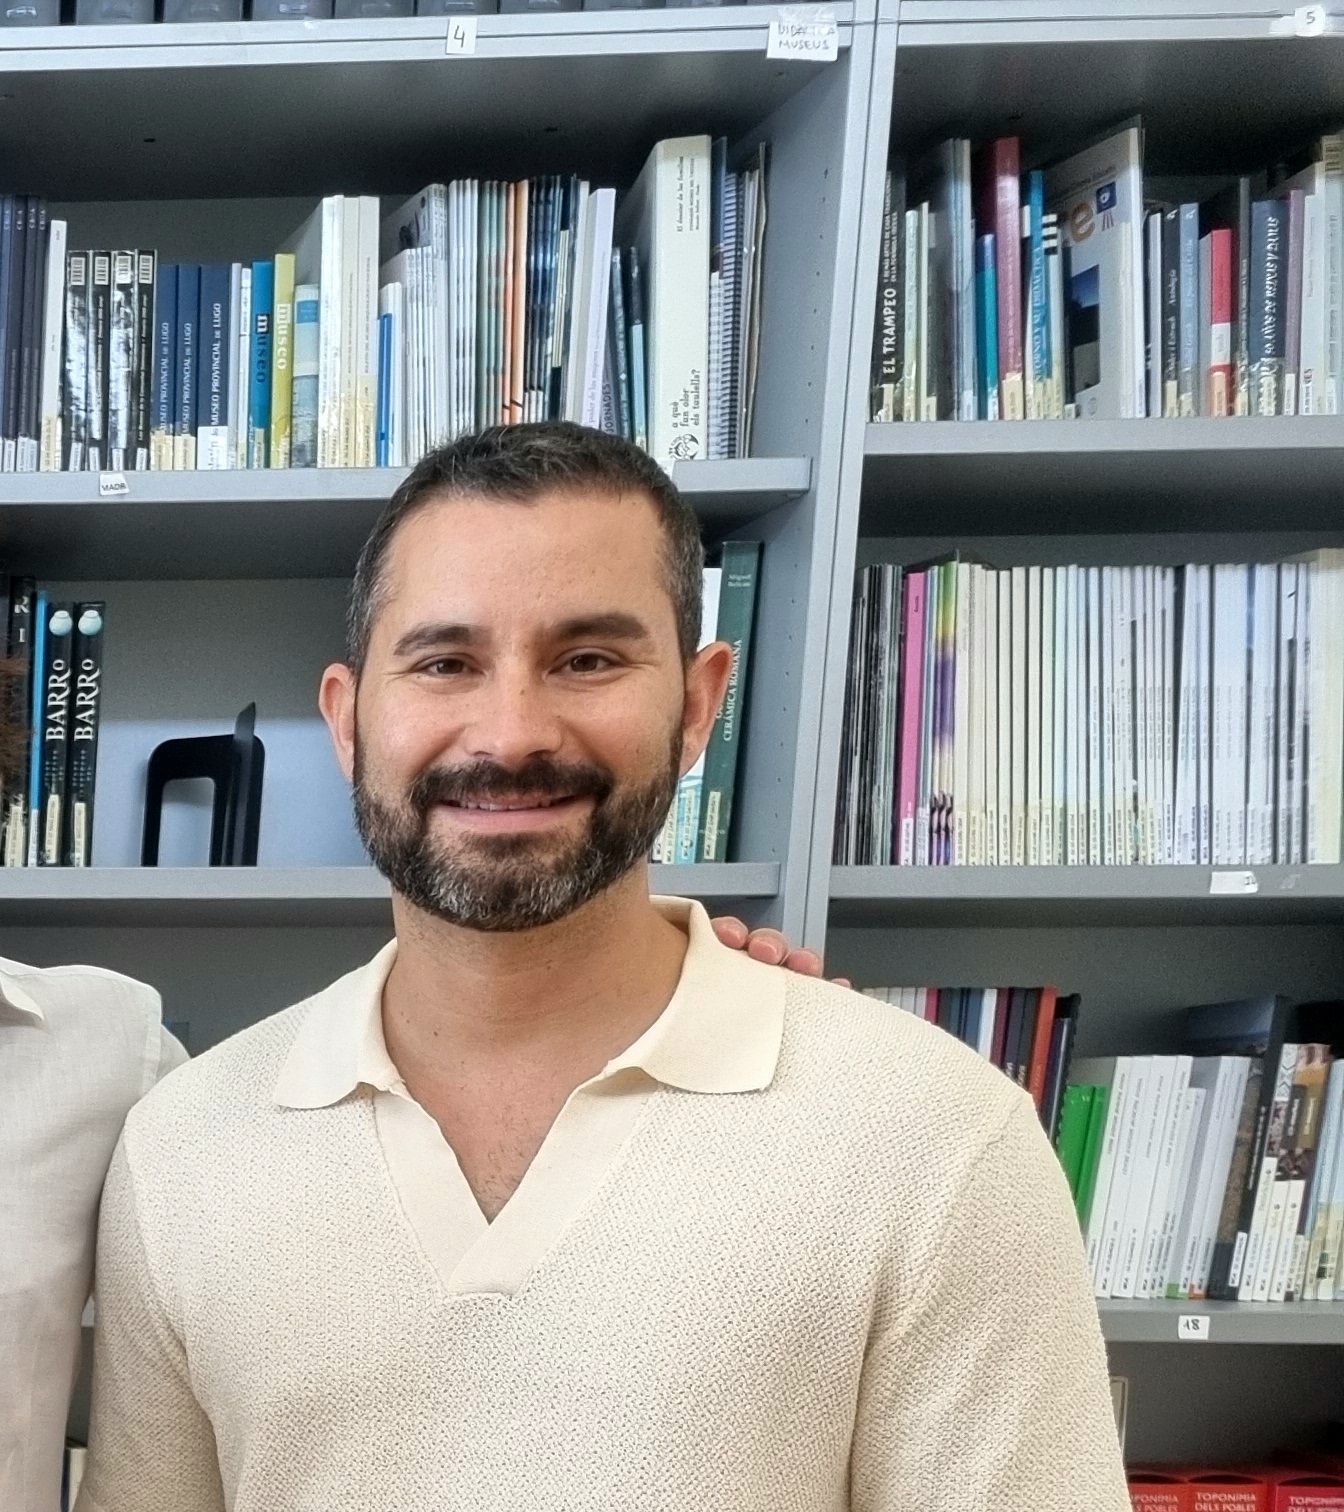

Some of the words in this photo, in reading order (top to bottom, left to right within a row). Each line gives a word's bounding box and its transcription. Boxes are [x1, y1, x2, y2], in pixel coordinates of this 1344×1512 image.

[453, 25, 465, 48] 4
[212, 303, 223, 328] LUGO
[882, 287, 896, 352] TRAMPEO
